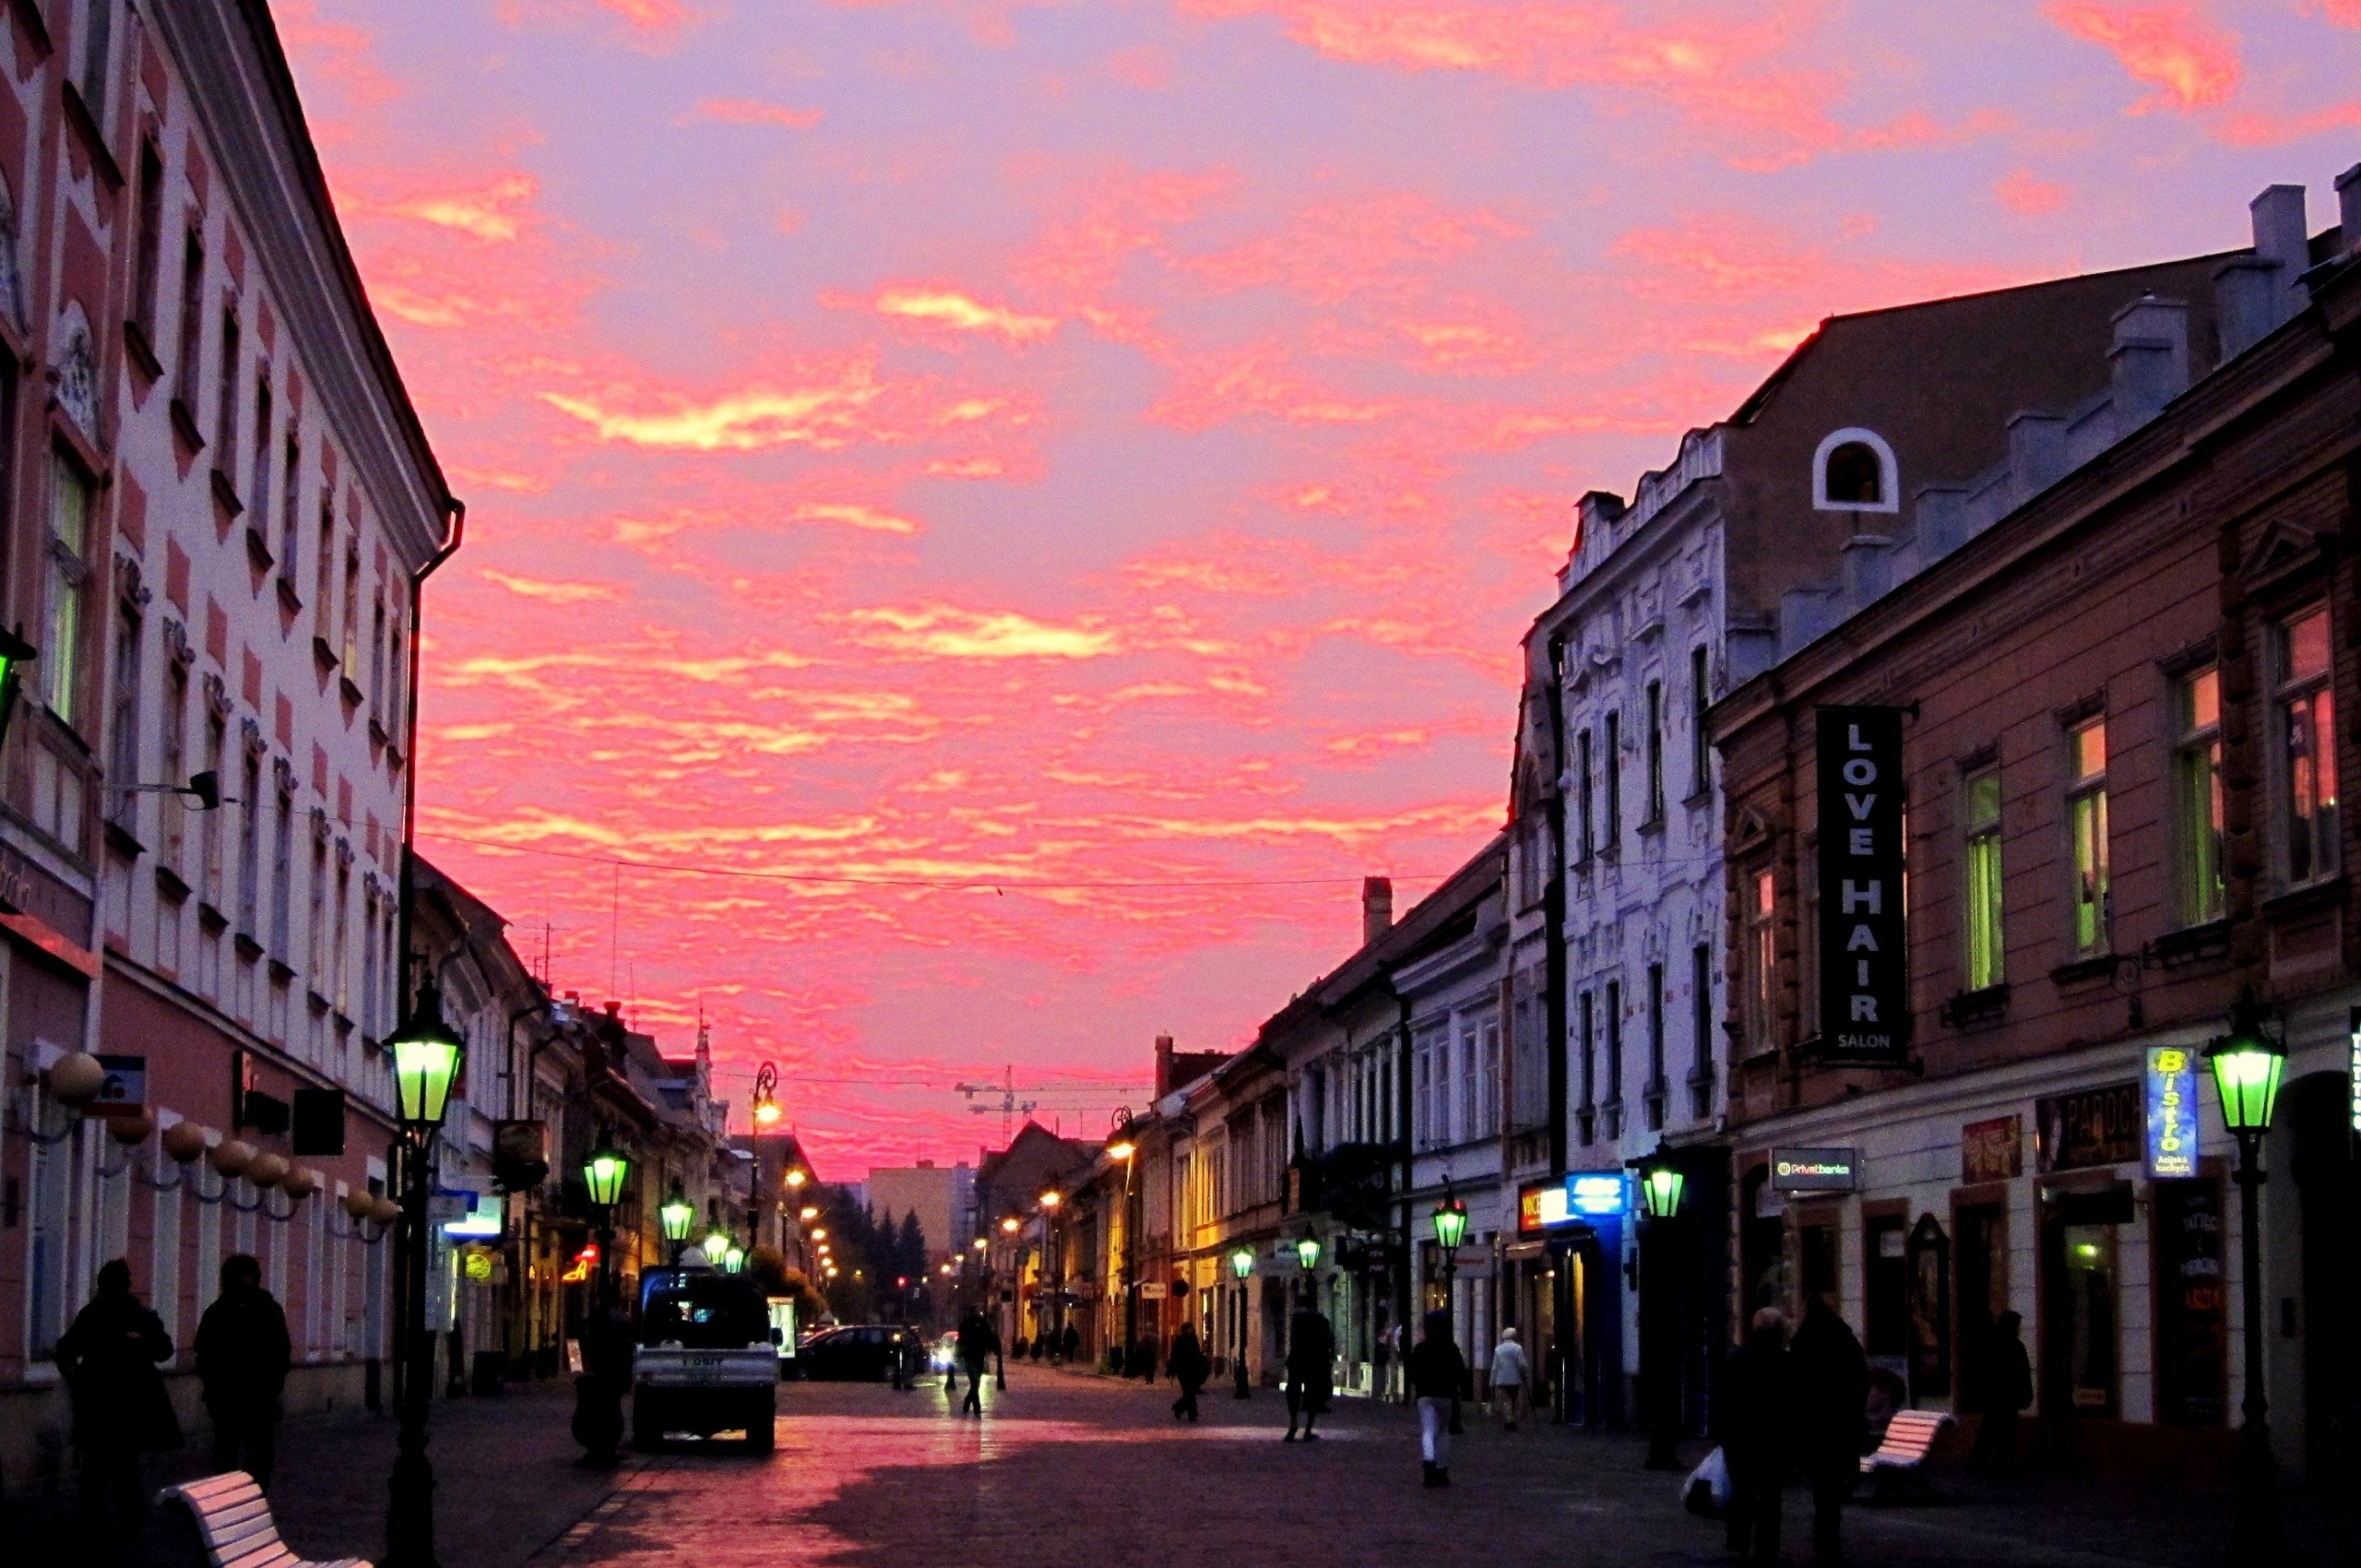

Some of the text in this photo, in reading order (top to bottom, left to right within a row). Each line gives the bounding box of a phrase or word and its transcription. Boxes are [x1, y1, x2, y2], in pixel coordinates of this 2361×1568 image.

[1842, 724, 1882, 1023] LOVE HAIR
[1838, 1034, 1891, 1050] SALON
[2157, 1051, 2186, 1151] Bistro
